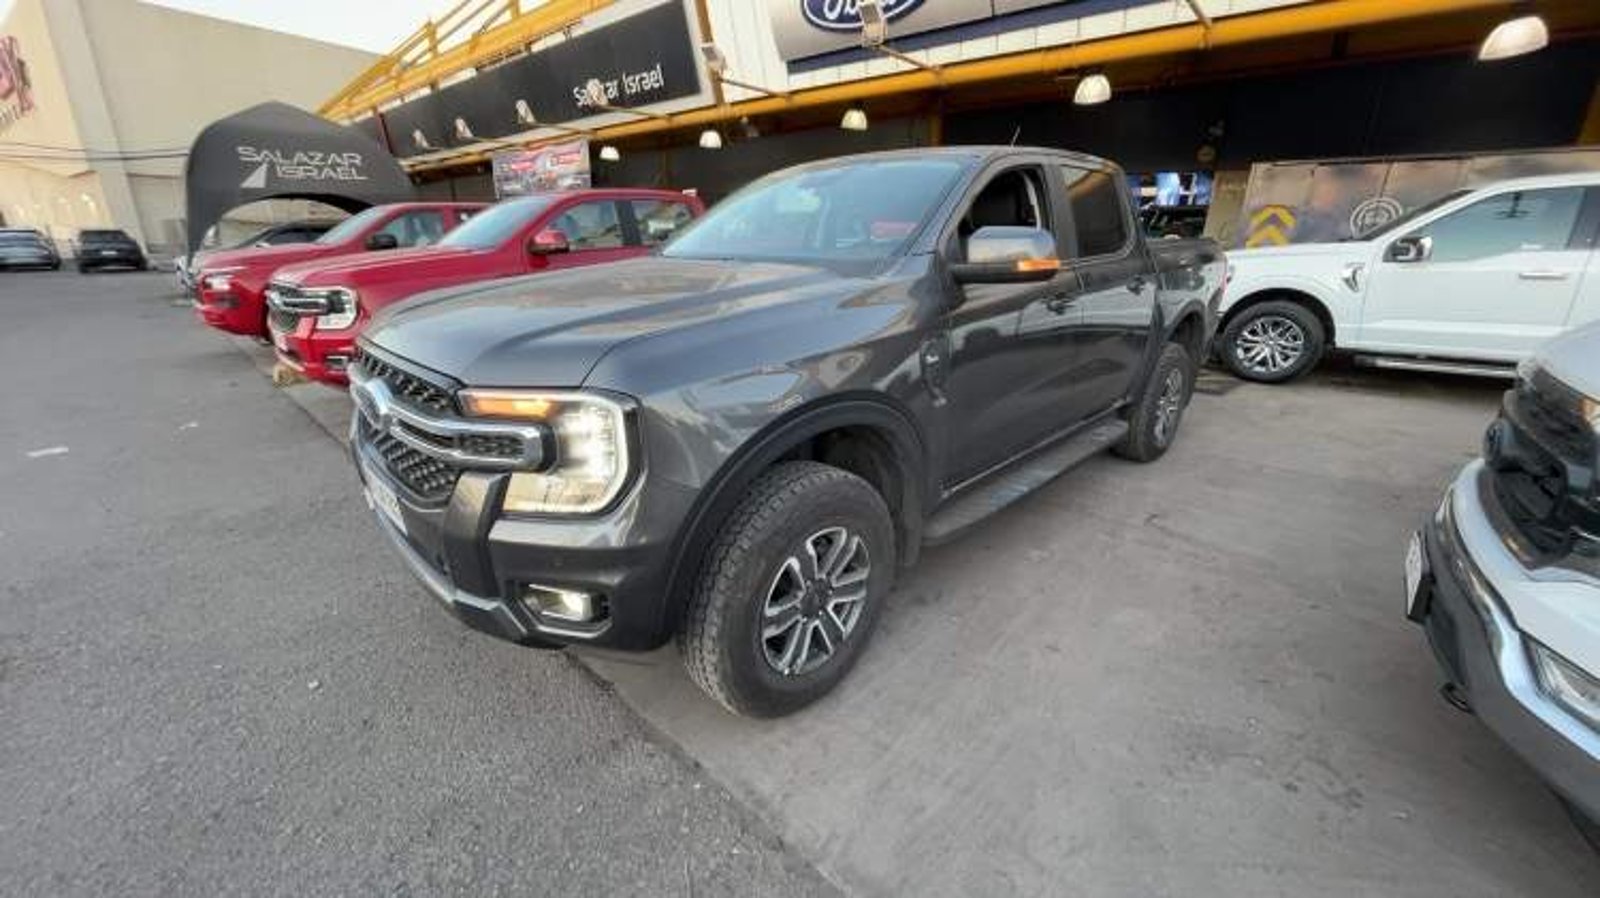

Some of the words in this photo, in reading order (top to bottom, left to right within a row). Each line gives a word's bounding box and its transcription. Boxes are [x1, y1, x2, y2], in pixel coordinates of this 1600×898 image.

[573, 79, 619, 107] Saar
[622, 63, 664, 95] Israel
[237, 146, 363, 166] SALAZAR
[275, 164, 369, 181] ISRAEL
